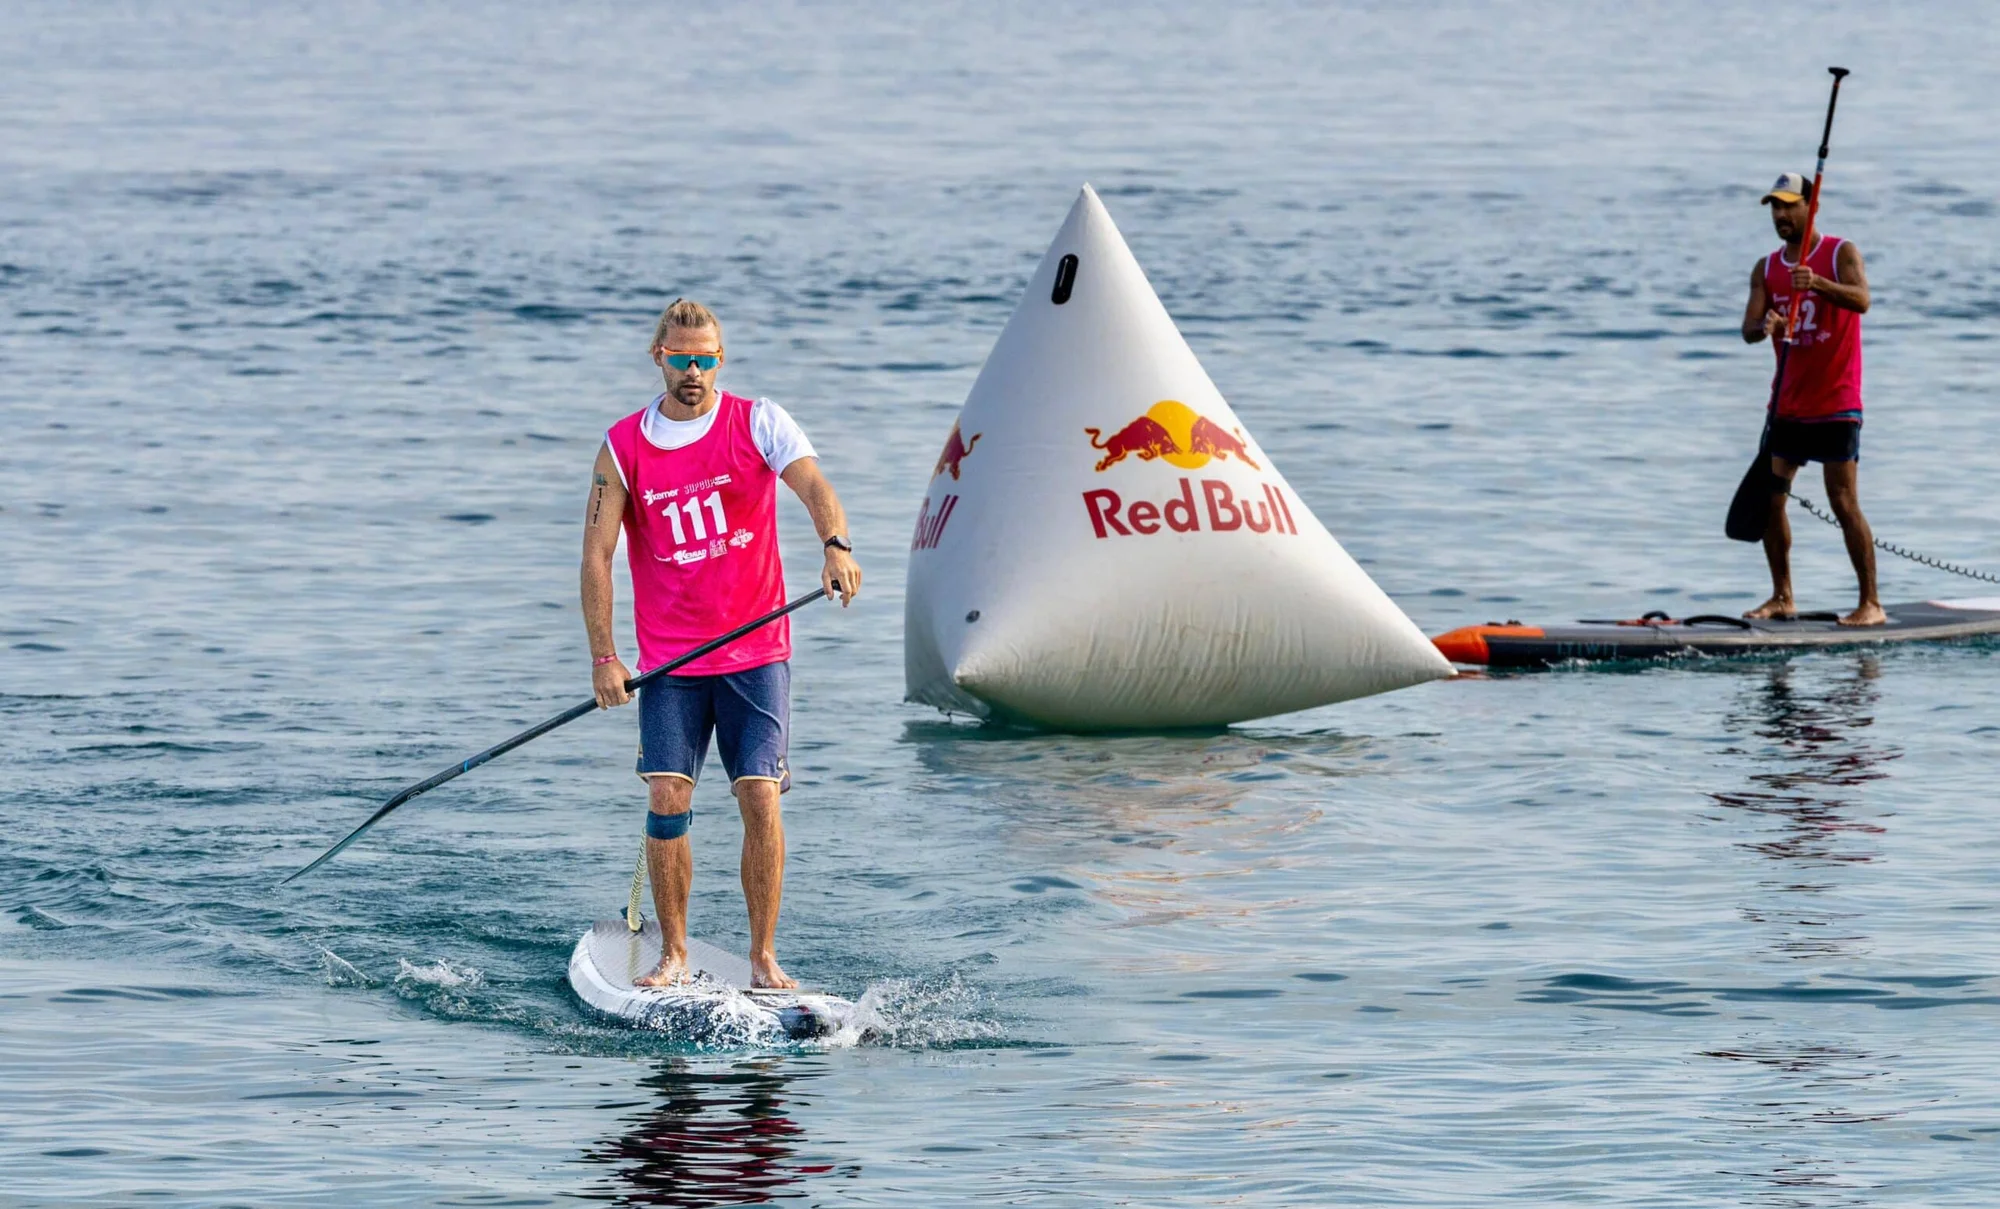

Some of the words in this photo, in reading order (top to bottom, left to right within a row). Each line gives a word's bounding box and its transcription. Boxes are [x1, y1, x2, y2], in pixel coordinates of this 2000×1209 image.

[661, 490, 728, 545] 111
[1082, 478, 1200, 539] Red
[1201, 479, 1298, 536] Bull
